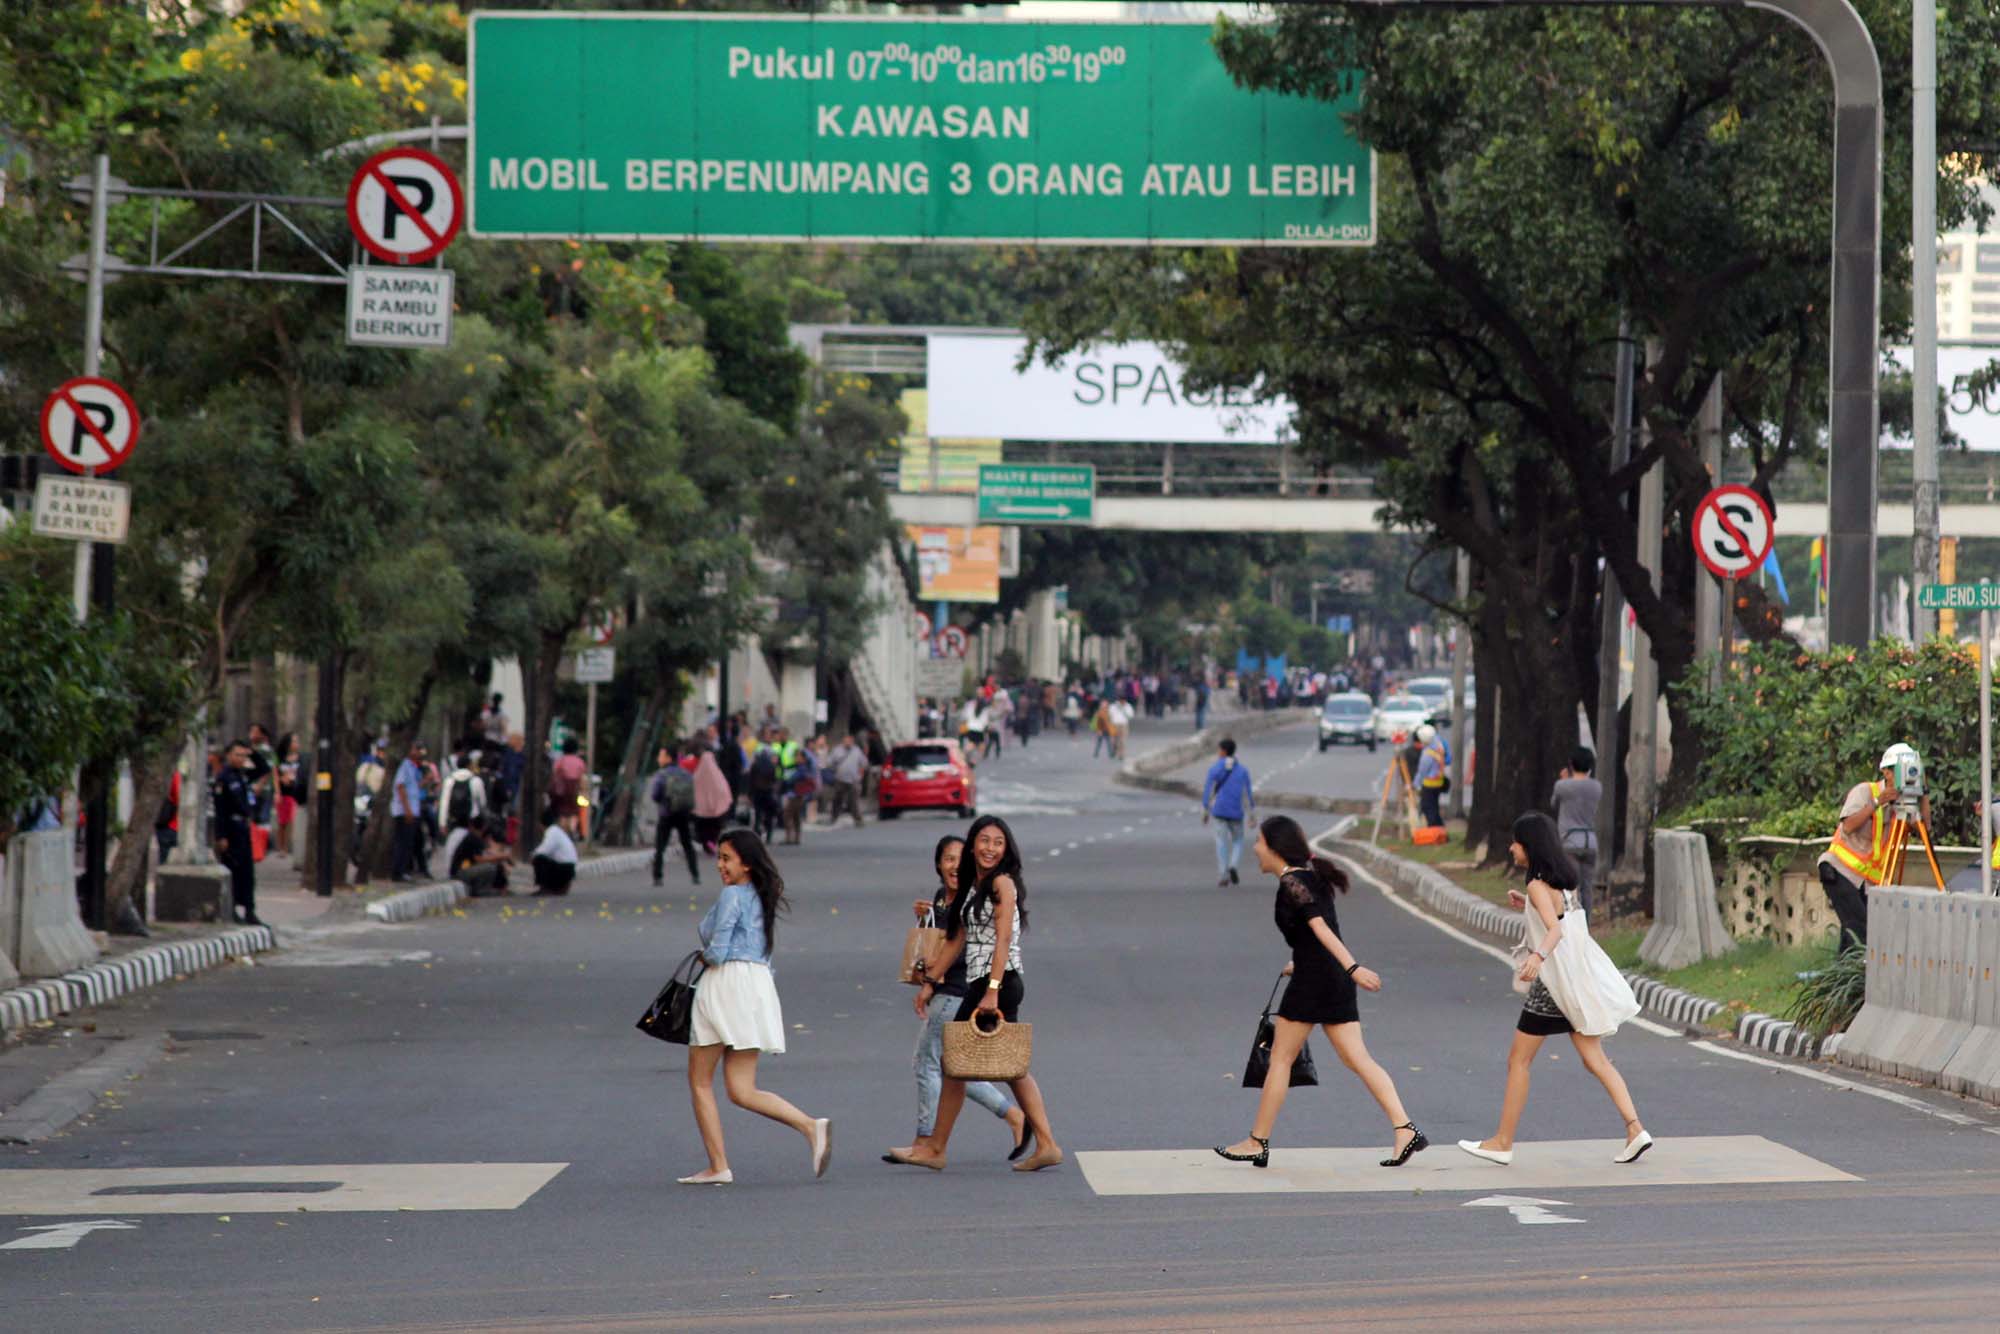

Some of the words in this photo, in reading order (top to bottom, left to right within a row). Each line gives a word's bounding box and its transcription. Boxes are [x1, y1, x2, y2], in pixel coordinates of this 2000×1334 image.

[729, 46, 834, 79] Pukul
[817, 104, 1030, 138] KAWASAN
[489, 158, 608, 191] MOBIL
[625, 159, 929, 194] BERPENUMPANG
[949, 162, 972, 196] 3
[987, 163, 1123, 196] ORANG
[1141, 164, 1232, 196] ATAU
[1248, 165, 1355, 196] LEBIH
[363, 277, 440, 295] SAMPAI
[362, 299, 437, 316] RAMBU
[354, 319, 443, 337] BERIKUT
[50, 484, 116, 502] SAMPAI
[48, 499, 113, 519] RAMBU
[40, 513, 118, 535] BERIKUT
